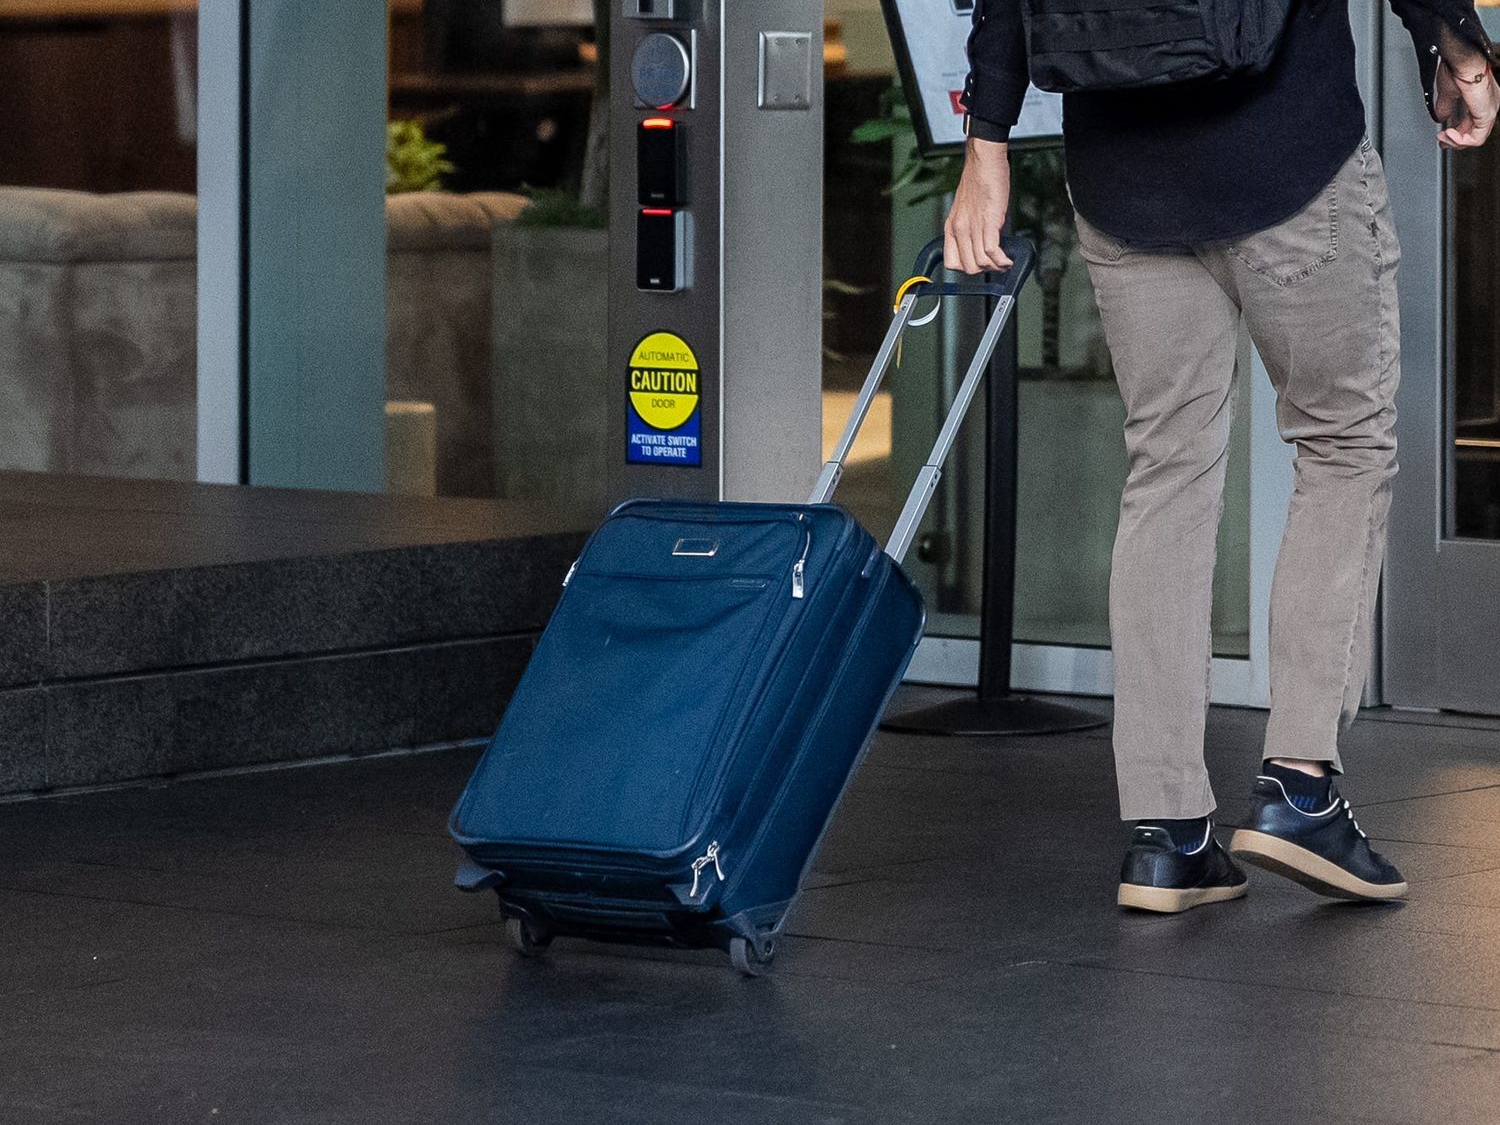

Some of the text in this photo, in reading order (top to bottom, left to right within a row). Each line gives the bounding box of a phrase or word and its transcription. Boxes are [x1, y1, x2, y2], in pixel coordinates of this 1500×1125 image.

[639, 351, 689, 362] AUTOMATIC
[631, 370, 697, 393] CAUTION
[651, 398, 675, 408] DOOR
[631, 434, 697, 447] ACTIVATE SWITCH
[642, 445, 687, 458] TO OPERATE
